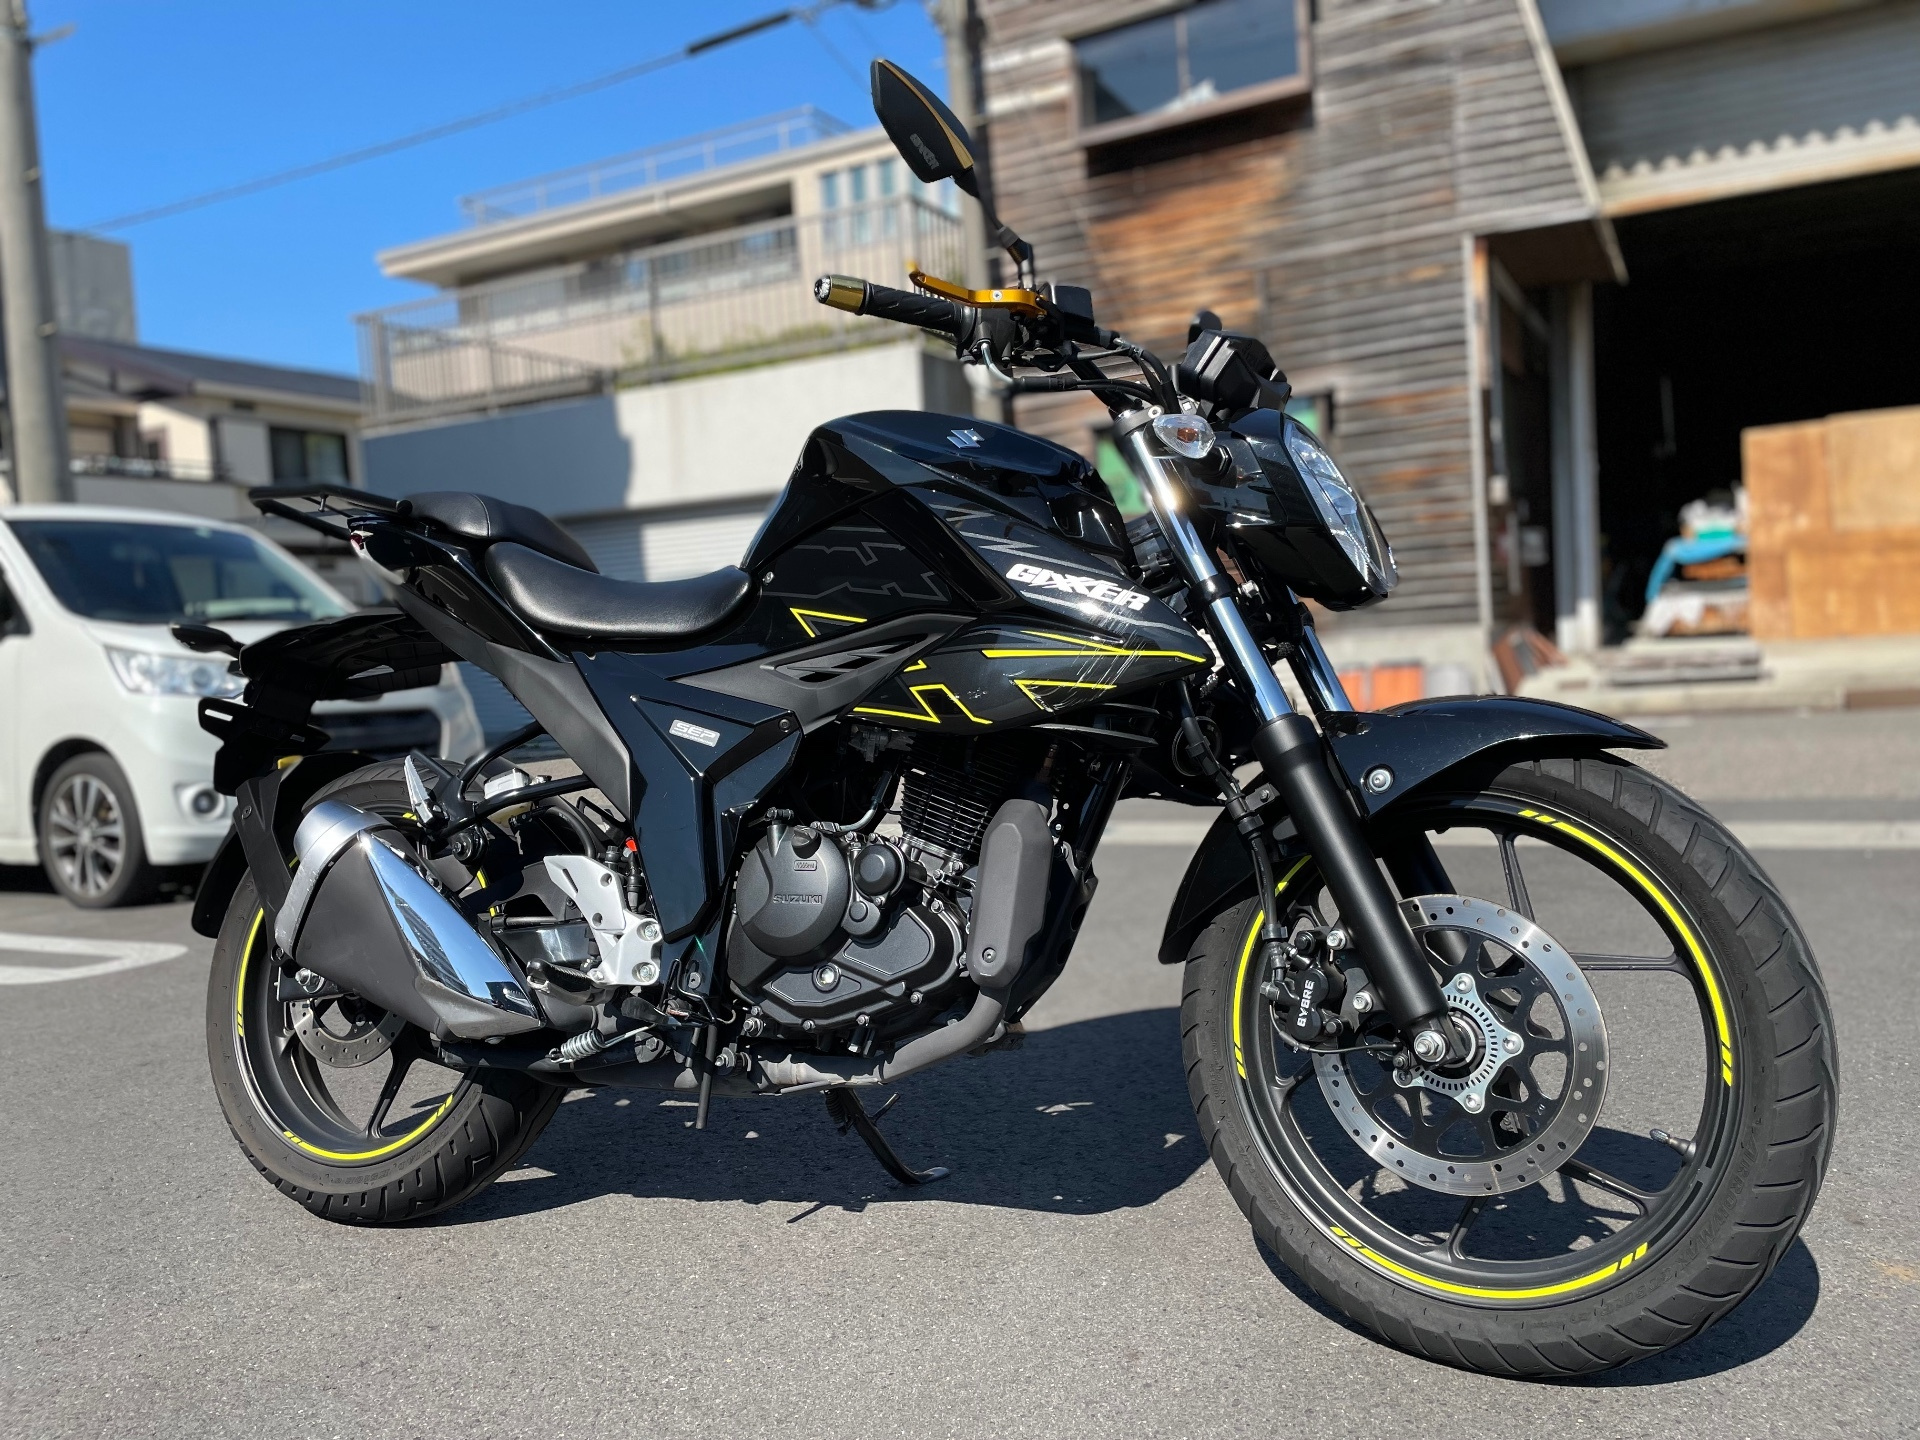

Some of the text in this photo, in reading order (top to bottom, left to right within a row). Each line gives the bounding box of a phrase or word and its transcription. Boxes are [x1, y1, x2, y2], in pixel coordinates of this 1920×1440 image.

[1005, 563, 1151, 611] GIXXER
[673, 722, 716, 739] SEP
[773, 894, 823, 905] SUZUKI
[1296, 979, 1315, 1028] BYBRE
